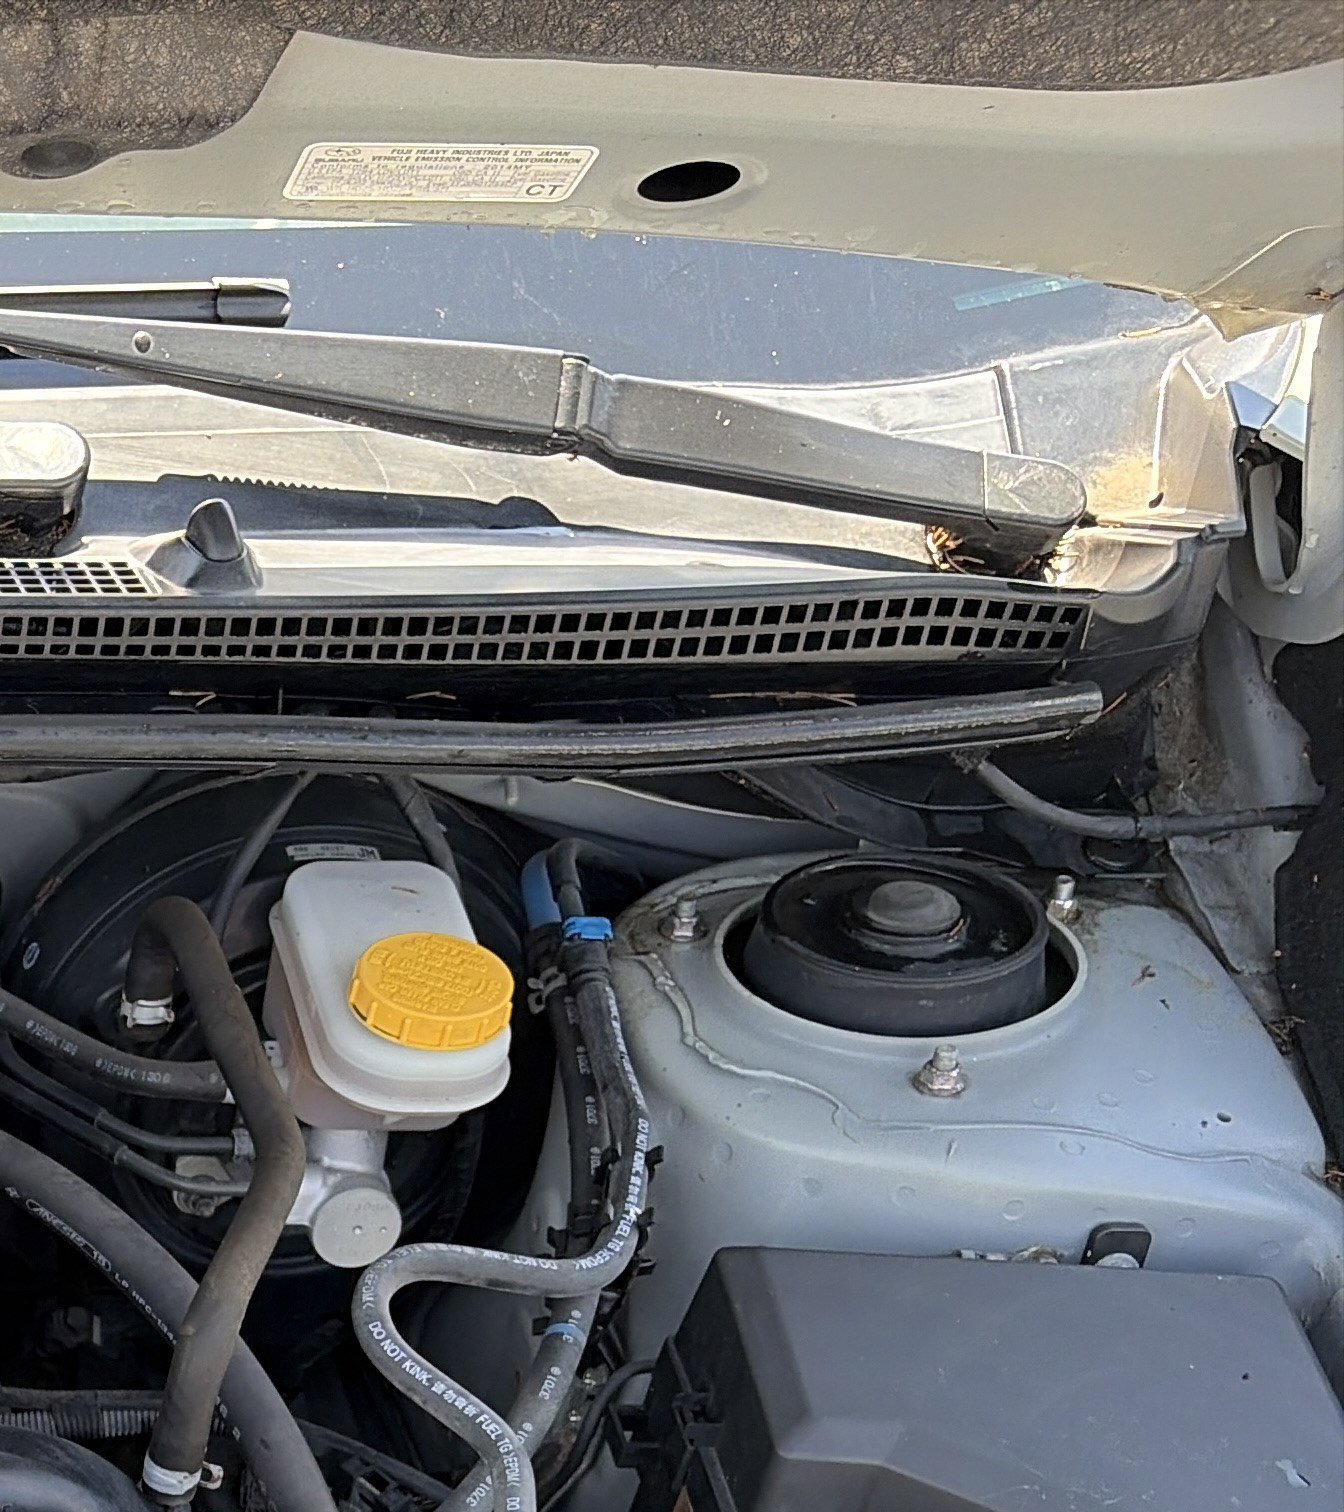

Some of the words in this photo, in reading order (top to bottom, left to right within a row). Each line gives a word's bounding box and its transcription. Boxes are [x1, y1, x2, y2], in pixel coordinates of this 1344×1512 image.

[525, 184, 563, 196] CT
[368, 1322, 386, 1340] DO
[380, 1337, 404, 1362] NOT
[474, 1414, 502, 1441] FUEL
[539, 1374, 555, 1400] 3701
[506, 1497, 520, 1511] DO
